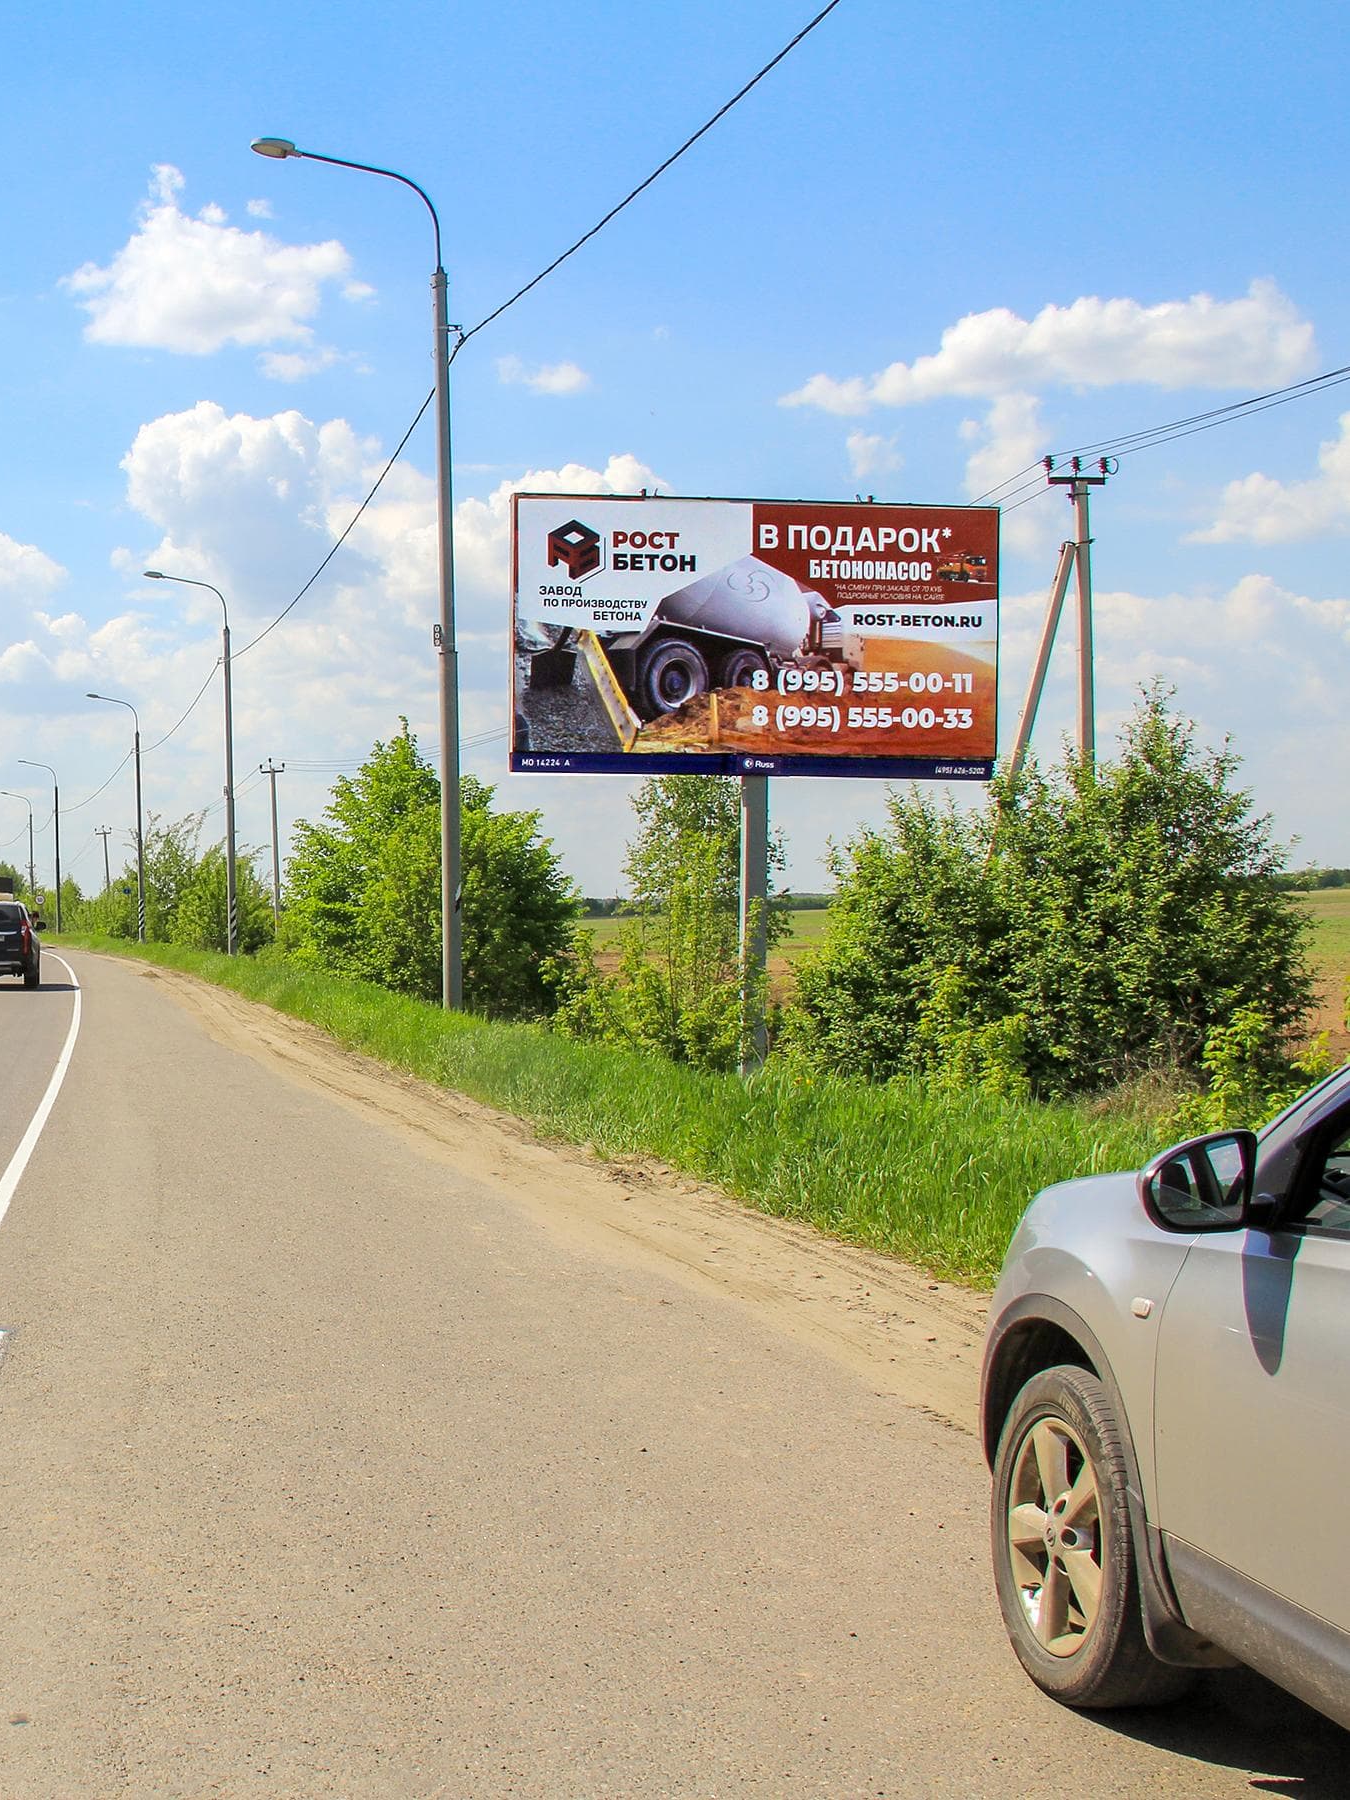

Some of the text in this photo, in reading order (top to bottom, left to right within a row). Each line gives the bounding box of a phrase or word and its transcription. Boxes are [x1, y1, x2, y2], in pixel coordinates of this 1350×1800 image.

[612, 531, 680, 550] РОСТ
[759, 523, 779, 549] В
[612, 553, 696, 572] БЕТОН
[809, 559, 932, 581] БЕТОНОНАСОС
[538, 585, 582, 597] ЗАВОД
[543, 599, 648, 609] ПО ПРОИЗВОДСТВУ
[593, 610, 642, 621] БЕТОНА
[853, 614, 982, 628] ROST-BETON.RU
[752, 669, 973, 696] 8 (995) 555-00-11
[752, 705, 973, 732] 8 (995) 555-00-33
[755, 760, 775, 769] Russ
